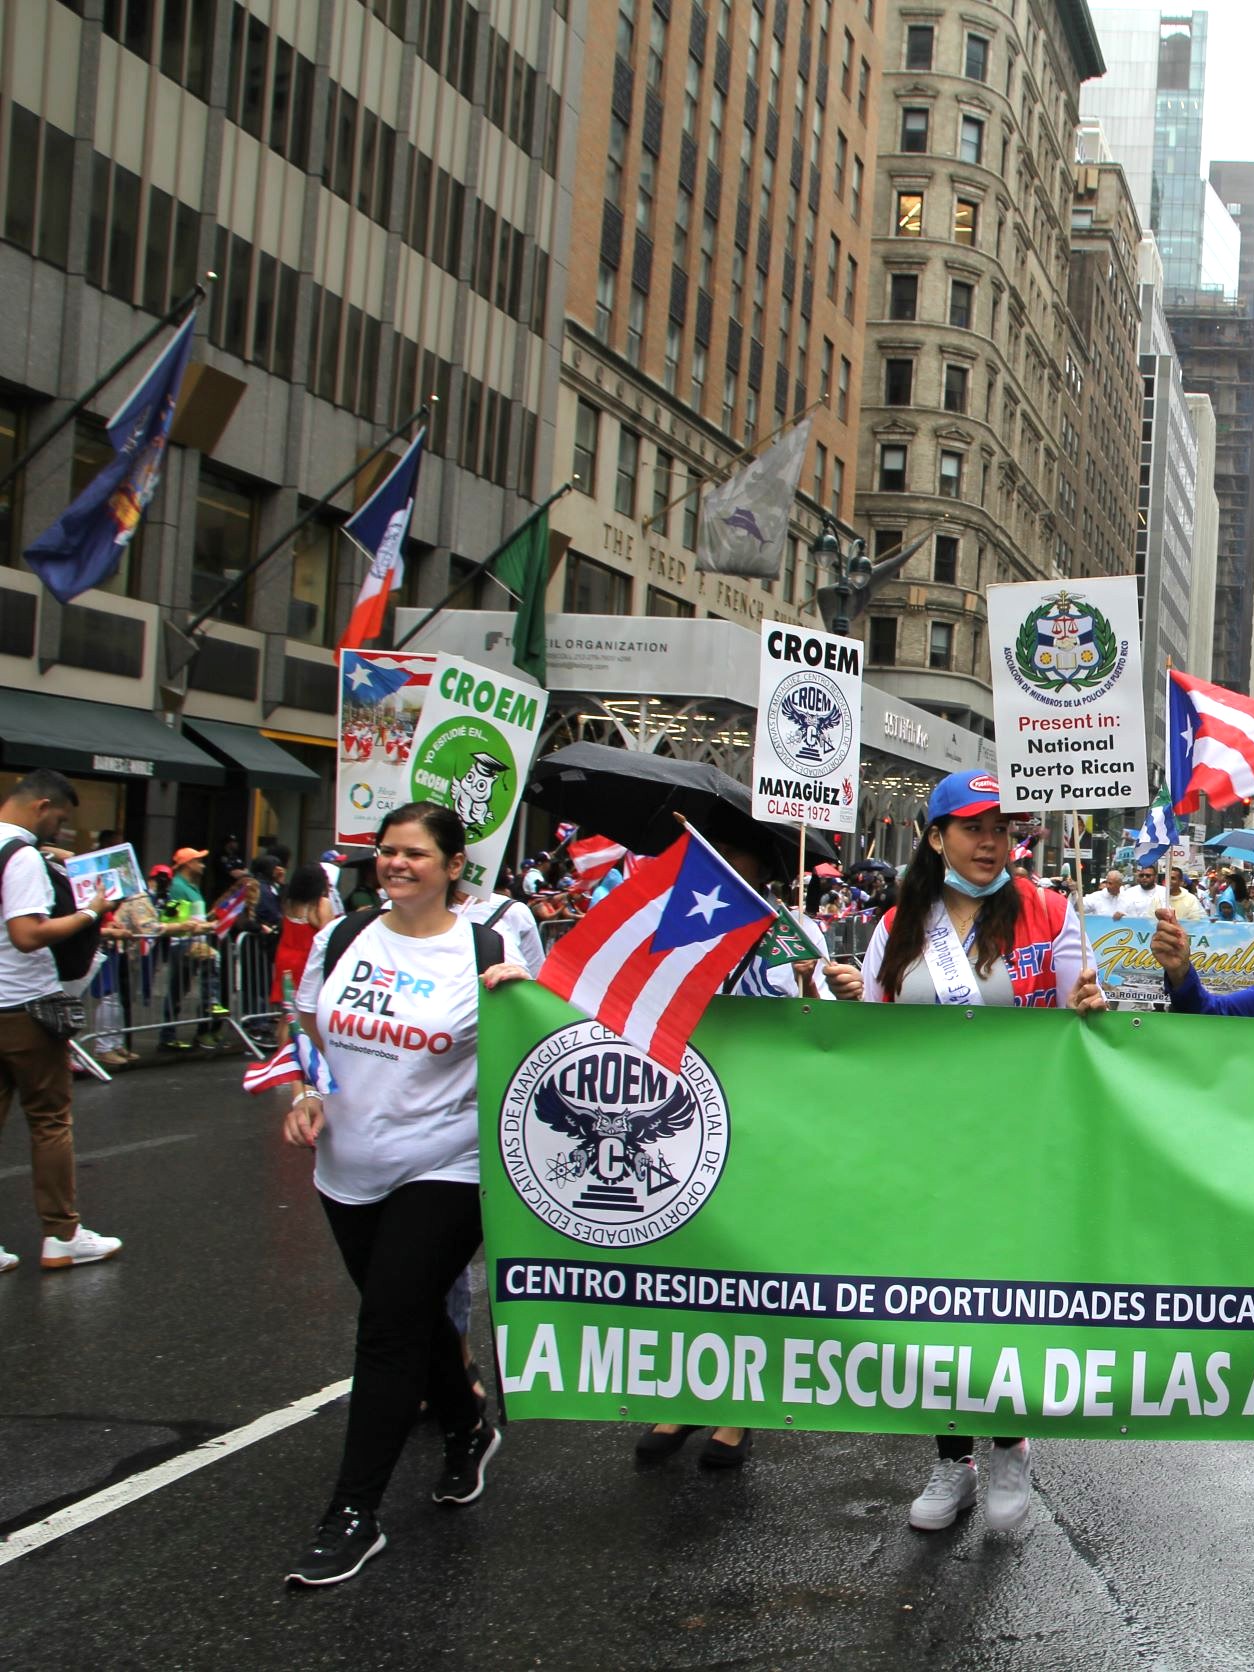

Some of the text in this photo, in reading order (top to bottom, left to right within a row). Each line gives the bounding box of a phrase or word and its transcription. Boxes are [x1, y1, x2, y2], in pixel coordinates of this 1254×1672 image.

[602, 522, 634, 562] THE
[649, 545, 687, 585] FRED
[717, 580, 764, 622] FRENCH
[565, 639, 669, 653] ORGANIZATION
[767, 630, 860, 676] CROEM
[1003, 646, 1023, 687] ASOCIACION
[1021, 683, 1031, 694] DE
[1029, 690, 1063, 708] MIEMBROS
[1063, 700, 1073, 708] DE
[1073, 698, 1081, 707] LA
[1104, 680, 1114, 691] DE
[1111, 657, 1127, 682] PUERTO
[1120, 640, 1129, 657] RICO
[439, 667, 538, 731] CROEM
[791, 686, 832, 713] CROEM
[804, 673, 831, 688] CENTRO
[829, 684, 852, 730] RESIDENCIAL
[1018, 713, 1120, 731] Present in:
[1028, 735, 1114, 754] National
[758, 776, 841, 806] MAYAGÜEZ
[1010, 759, 1135, 778] Puerto Rican
[767, 799, 804, 818] CLASE
[807, 805, 831, 822] 1972
[1016, 781, 1132, 804] Day Parade
[328, 1010, 453, 1055] MUNDO
[559, 1052, 668, 1105] CROEM
[680, 1055, 723, 1141] SIDENCIAL
[505, 1108, 522, 1132] DE
[505, 1137, 572, 1231] EDUCATIVAS
[704, 1150, 721, 1176] DE
[573, 1181, 707, 1245] OPORTUNIDADES
[506, 1265, 626, 1299] CENTRO
[635, 1272, 827, 1312] RESIDENCIAL
[835, 1282, 876, 1313] DE
[885, 1284, 1146, 1322] OPORTUNIDADES
[497, 1323, 564, 1394] LA
[578, 1325, 767, 1401] MEJOR
[782, 1337, 1027, 1416] ESCUELA
[1042, 1348, 1117, 1418] DE
[1130, 1350, 1231, 1417] LAS
